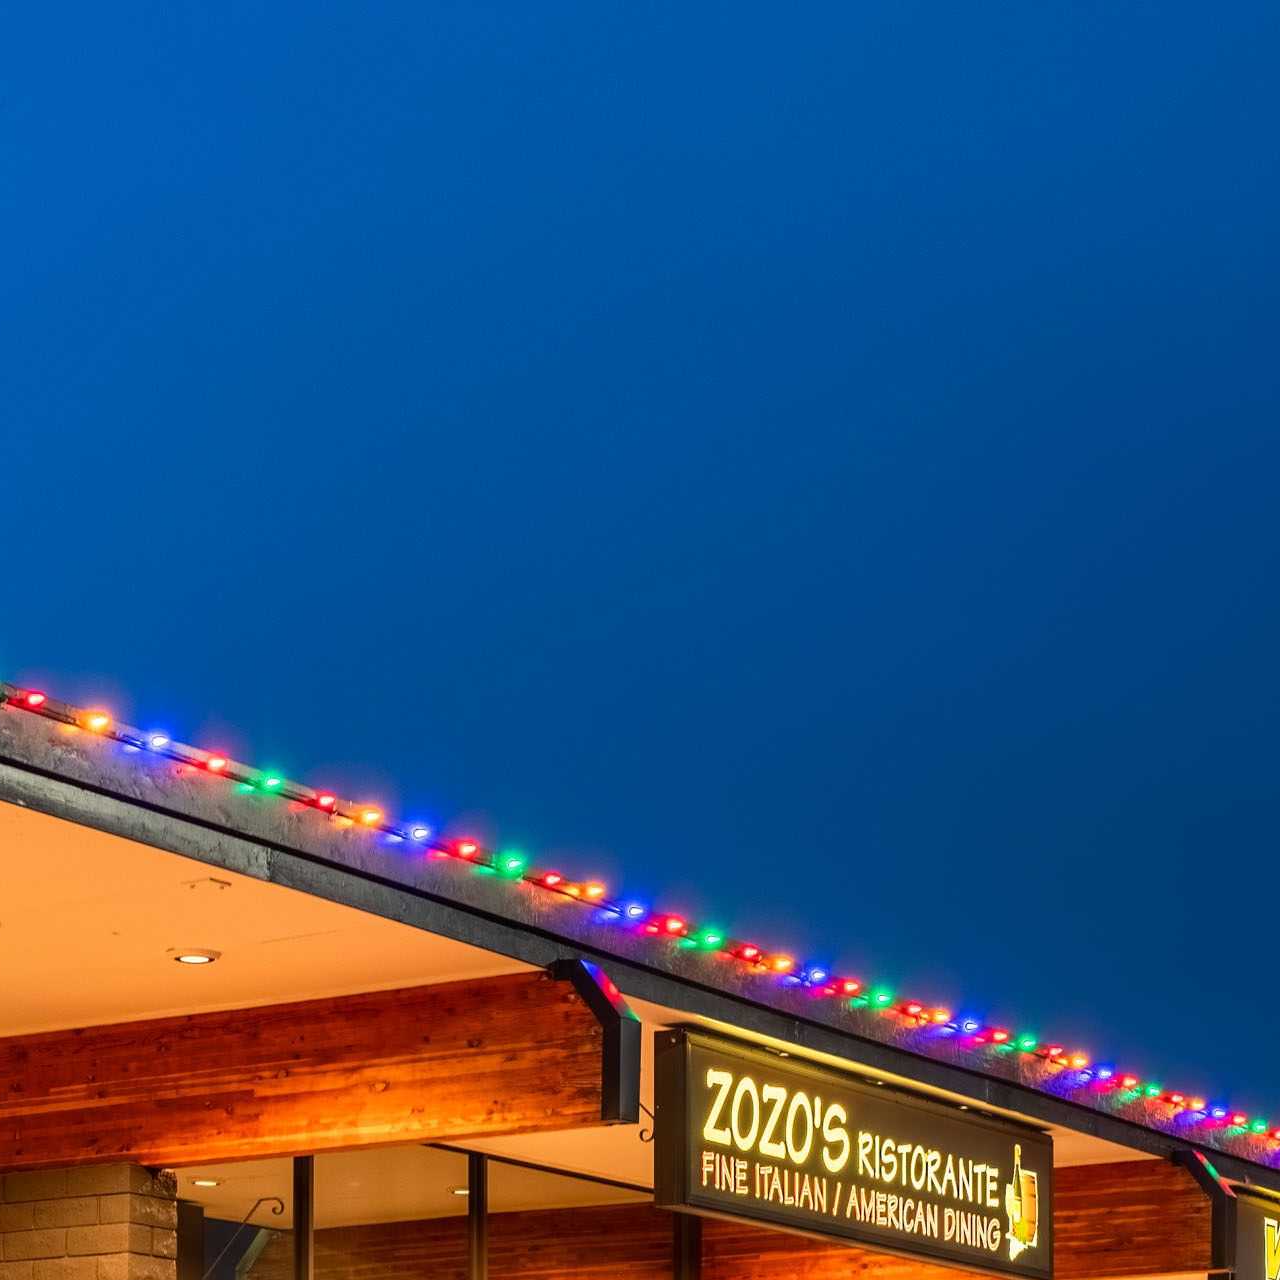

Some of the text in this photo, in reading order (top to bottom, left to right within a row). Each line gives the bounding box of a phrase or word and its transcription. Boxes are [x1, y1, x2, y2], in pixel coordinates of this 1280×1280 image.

[704, 1068, 1000, 1208] ZOZO'S RISTORANTE
[702, 1151, 749, 1194] FINE
[755, 1162, 827, 1214] ITALIAN
[846, 1184, 938, 1239] AMERICAN
[944, 1208, 1001, 1252] DINING
